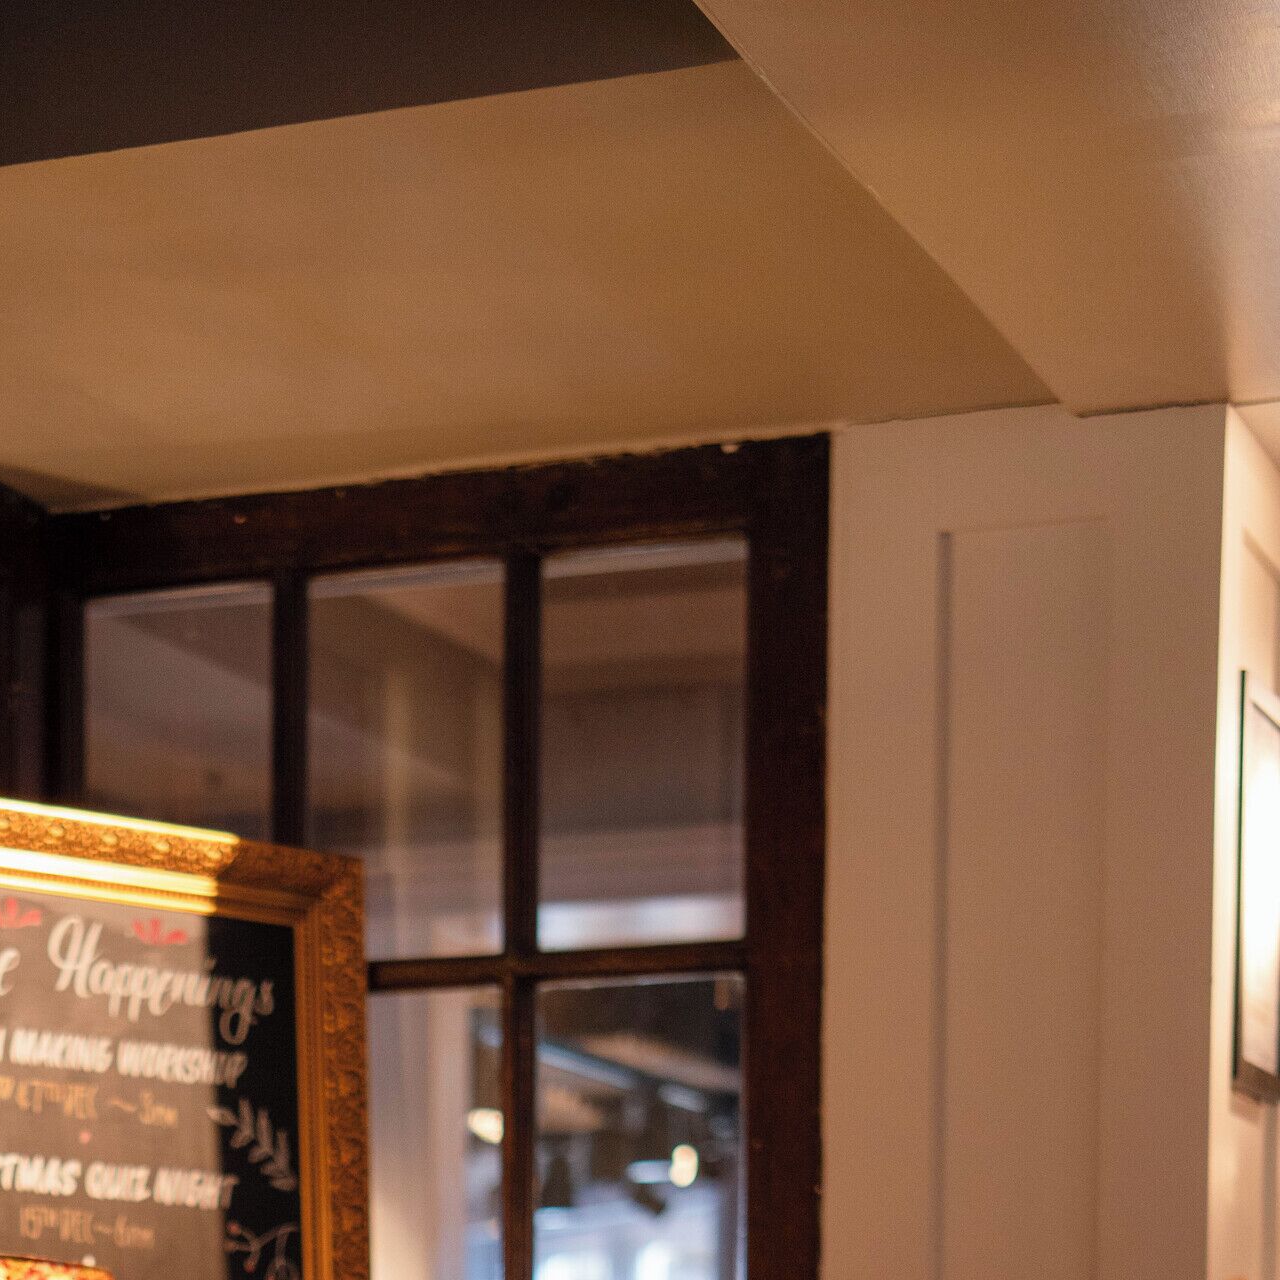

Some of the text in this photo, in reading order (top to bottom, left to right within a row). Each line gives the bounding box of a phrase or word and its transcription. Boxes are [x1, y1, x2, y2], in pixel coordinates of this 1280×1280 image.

[47, 915, 274, 1045] Happenings
[9, 1028, 114, 1074] MAKING
[116, 1040, 248, 1089] WORKSHOP
[84, 1161, 152, 1202] QUIZ
[153, 1166, 239, 1210] NIGHT
